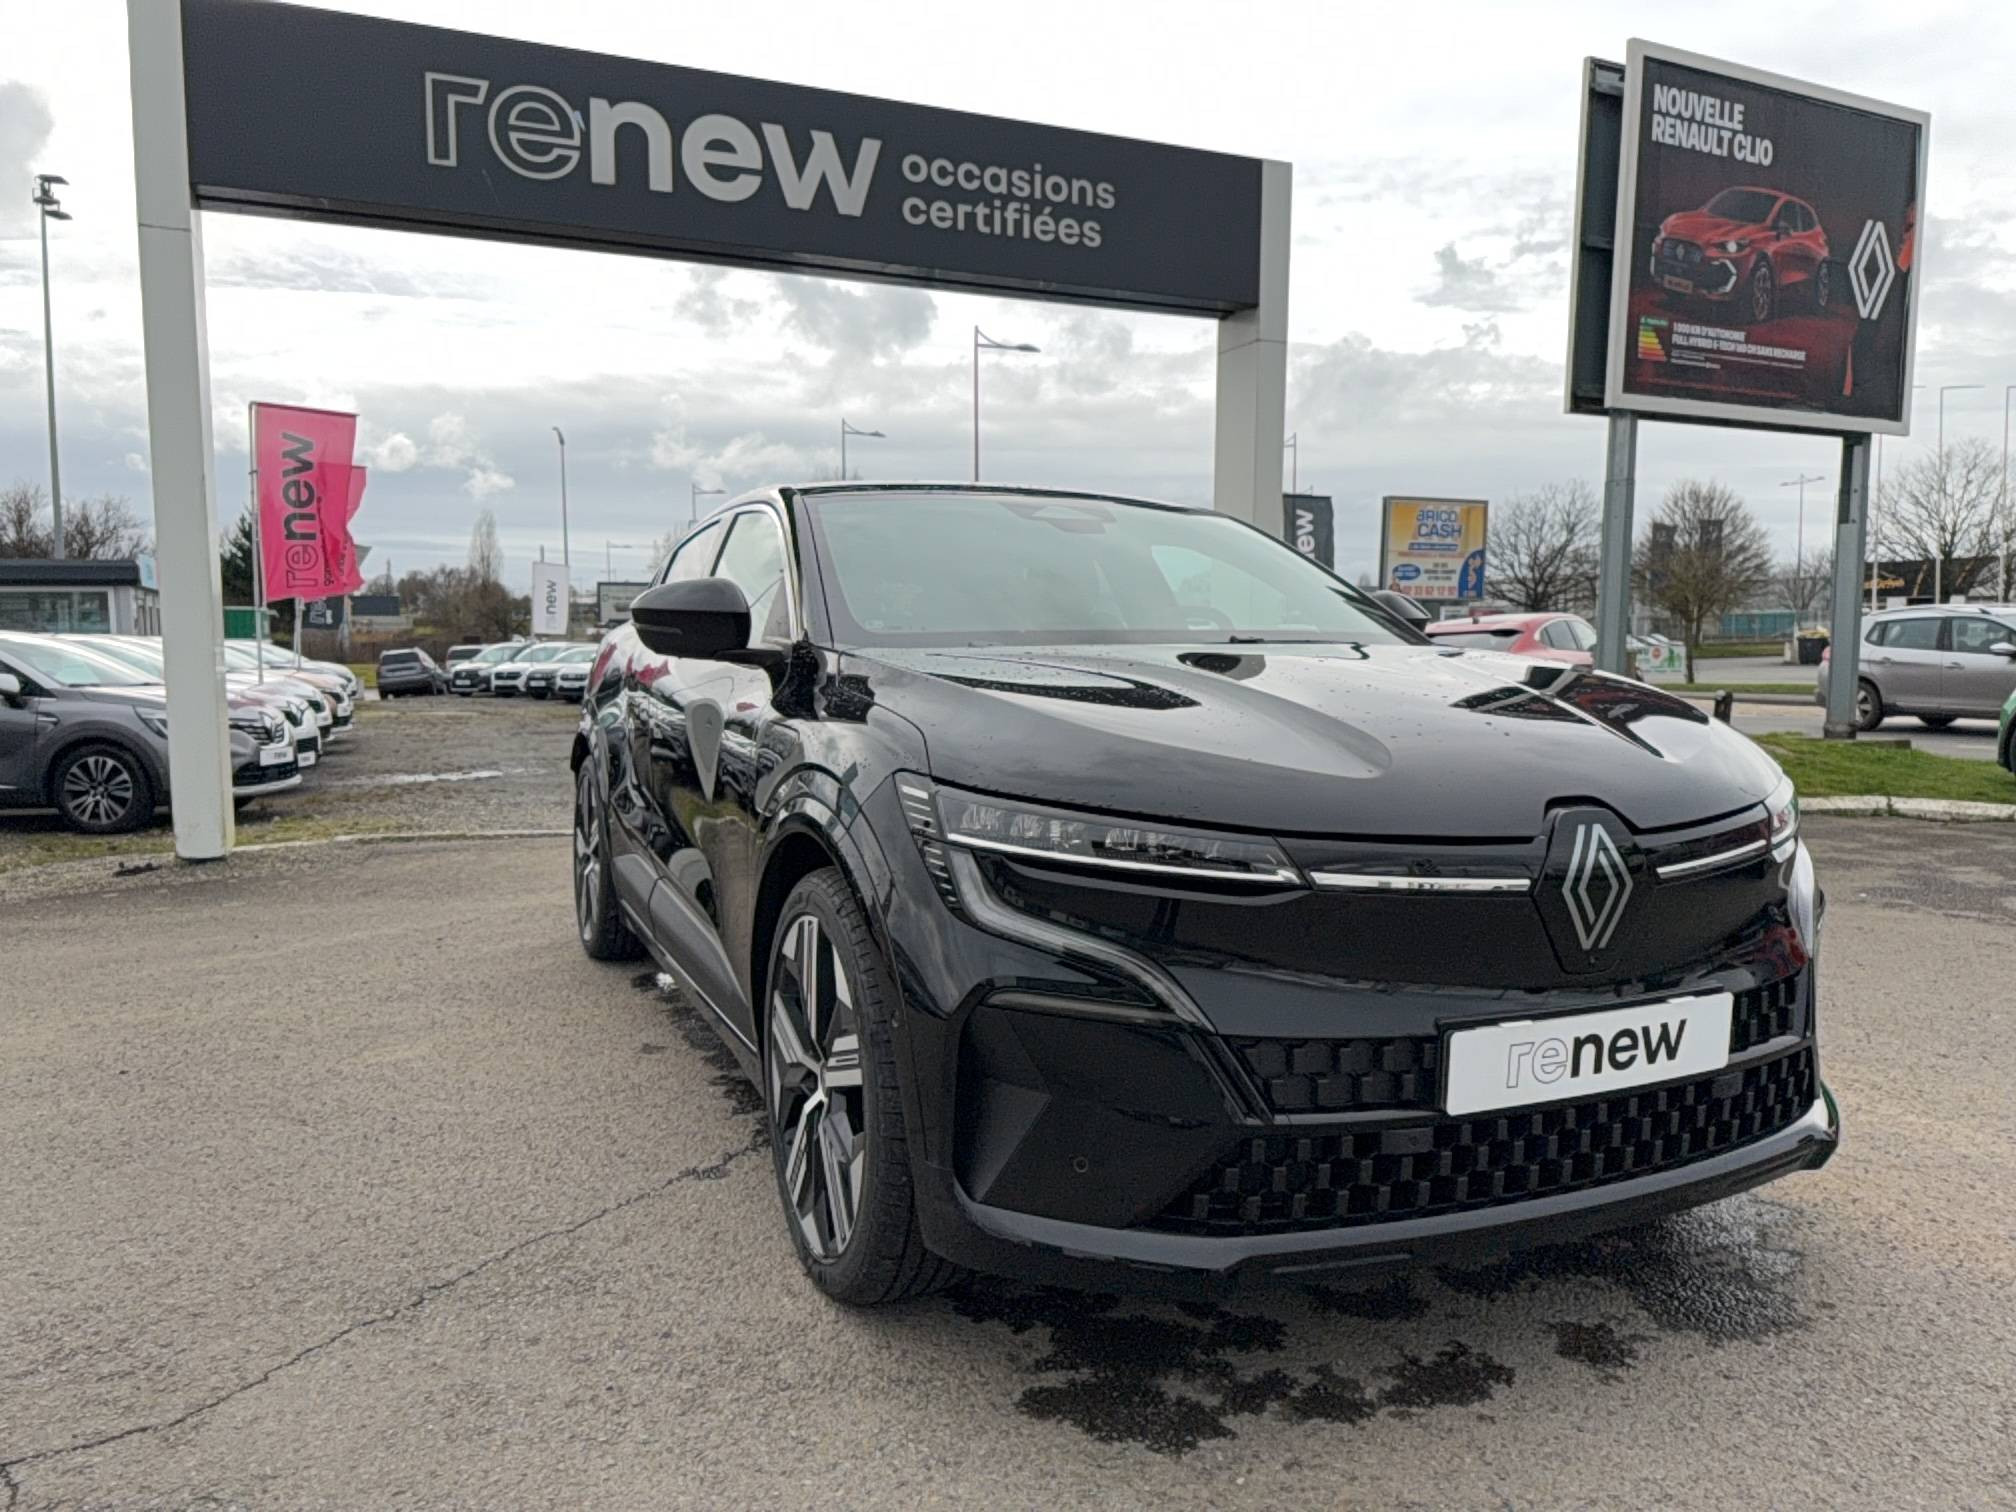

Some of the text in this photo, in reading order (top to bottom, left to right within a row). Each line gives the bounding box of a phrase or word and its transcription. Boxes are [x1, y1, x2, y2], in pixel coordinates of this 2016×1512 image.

[1653, 83, 1745, 131] NOUVELLE
[424, 71, 883, 217] renew
[1651, 113, 1774, 167] RENAULT CLIO
[901, 154, 1116, 209] occasions
[901, 196, 1102, 248] certifiées
[281, 432, 319, 588] renew
[1416, 509, 1457, 522] BRICO
[1418, 523, 1463, 538] CASH
[1506, 1018, 1687, 1089] renew
